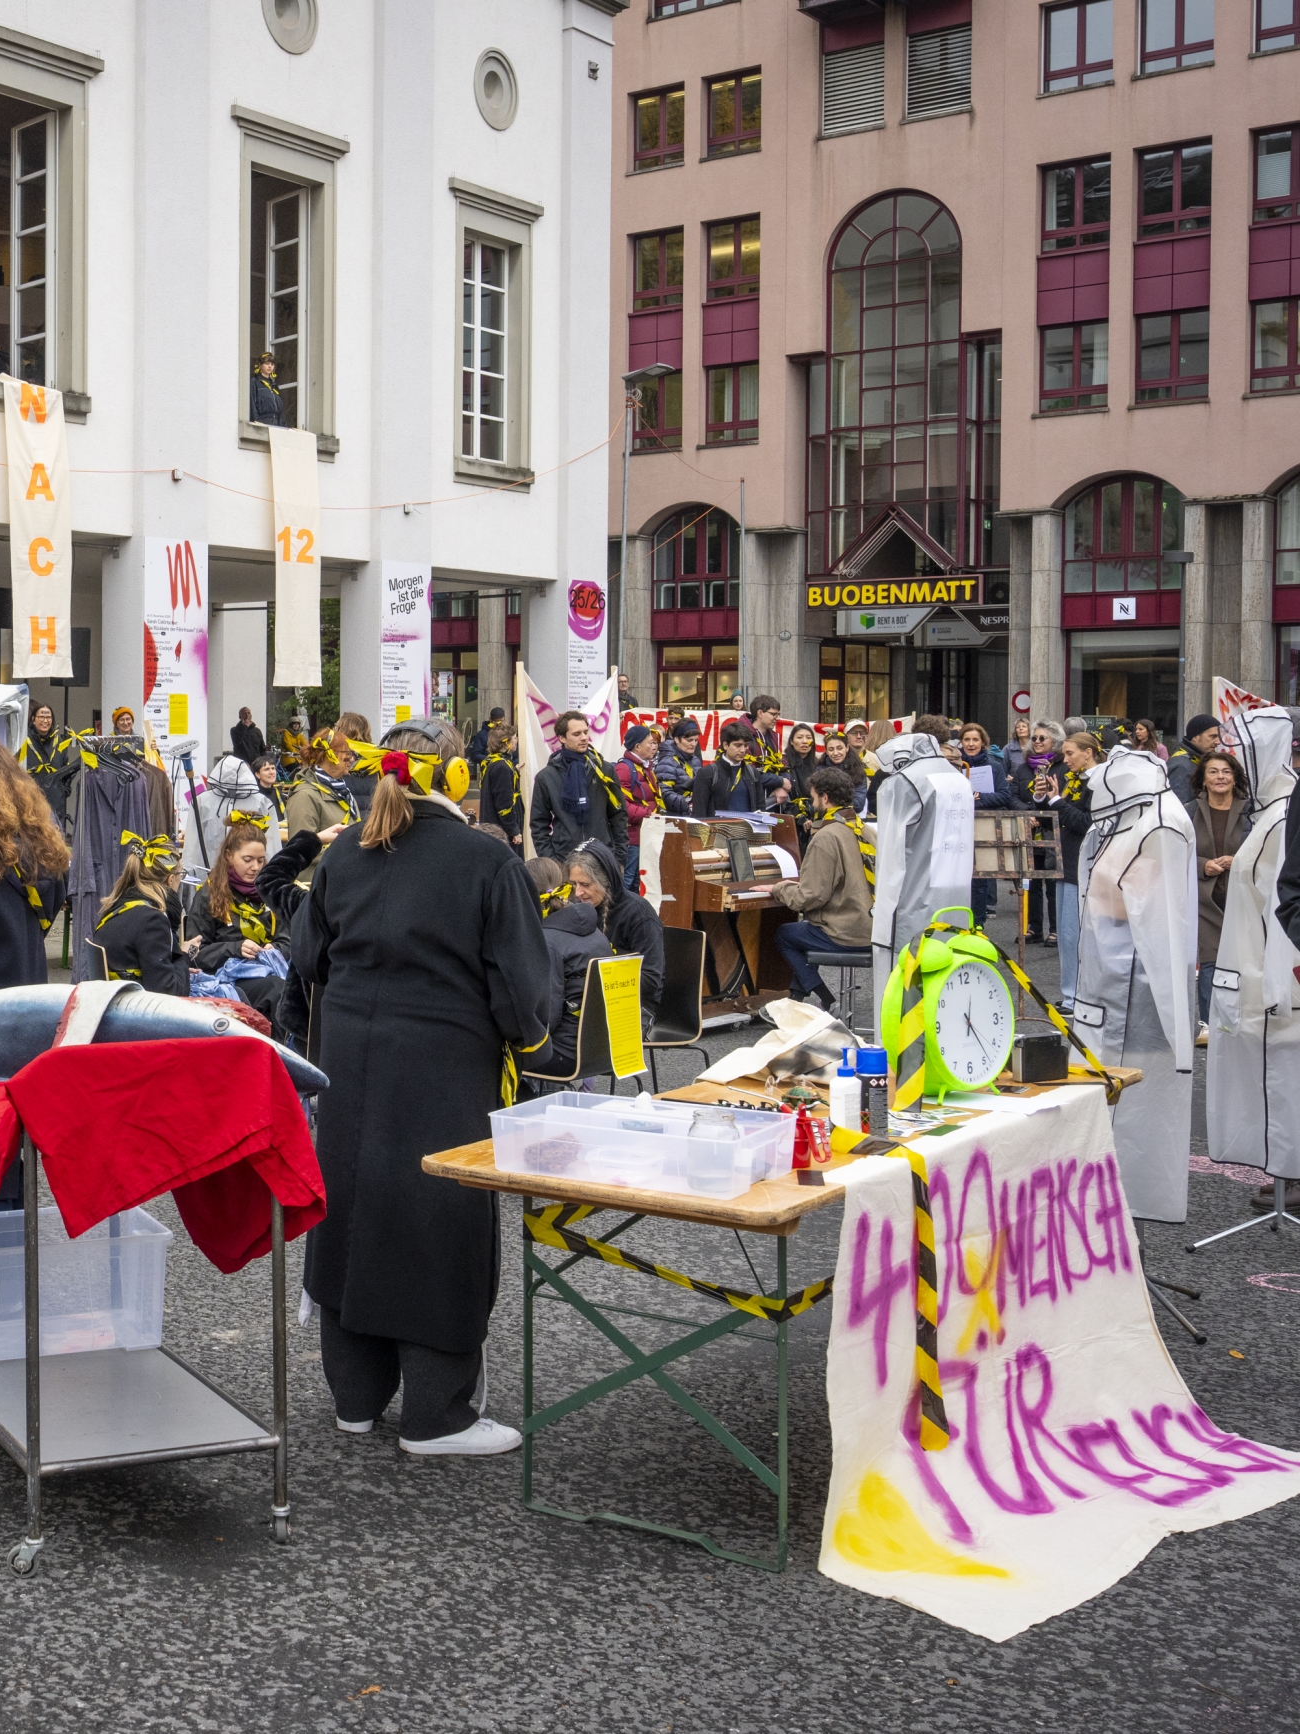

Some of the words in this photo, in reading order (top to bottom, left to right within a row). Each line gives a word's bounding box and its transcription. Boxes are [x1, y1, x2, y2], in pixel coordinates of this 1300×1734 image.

[19, 383, 57, 655] NACH
[277, 525, 315, 565] 12
[389, 575, 423, 591] Morgen
[398, 590, 409, 602] ist
[411, 586, 424, 599] die
[569, 589, 606, 610] 25/26
[808, 580, 976, 607] BUOBENMATT
[390, 601, 416, 615] Frage
[877, 616, 891, 625] RENT
[891, 616, 896, 625] A
[896, 615, 907, 624] BOX
[619, 979, 630, 988] nach
[958, 972, 970, 985] 12
[946, 981, 954, 990] 11
[989, 990, 993, 999] 2
[938, 999, 946, 1008] 10
[993, 1012, 999, 1026] 3
[935, 1021, 941, 1034] 9
[992, 1038, 996, 1047] 4
[940, 1046, 945, 1056] 8
[953, 1061, 958, 1071] 7
[966, 1061, 973, 1074] 6
[981, 1056, 987, 1066] 5
